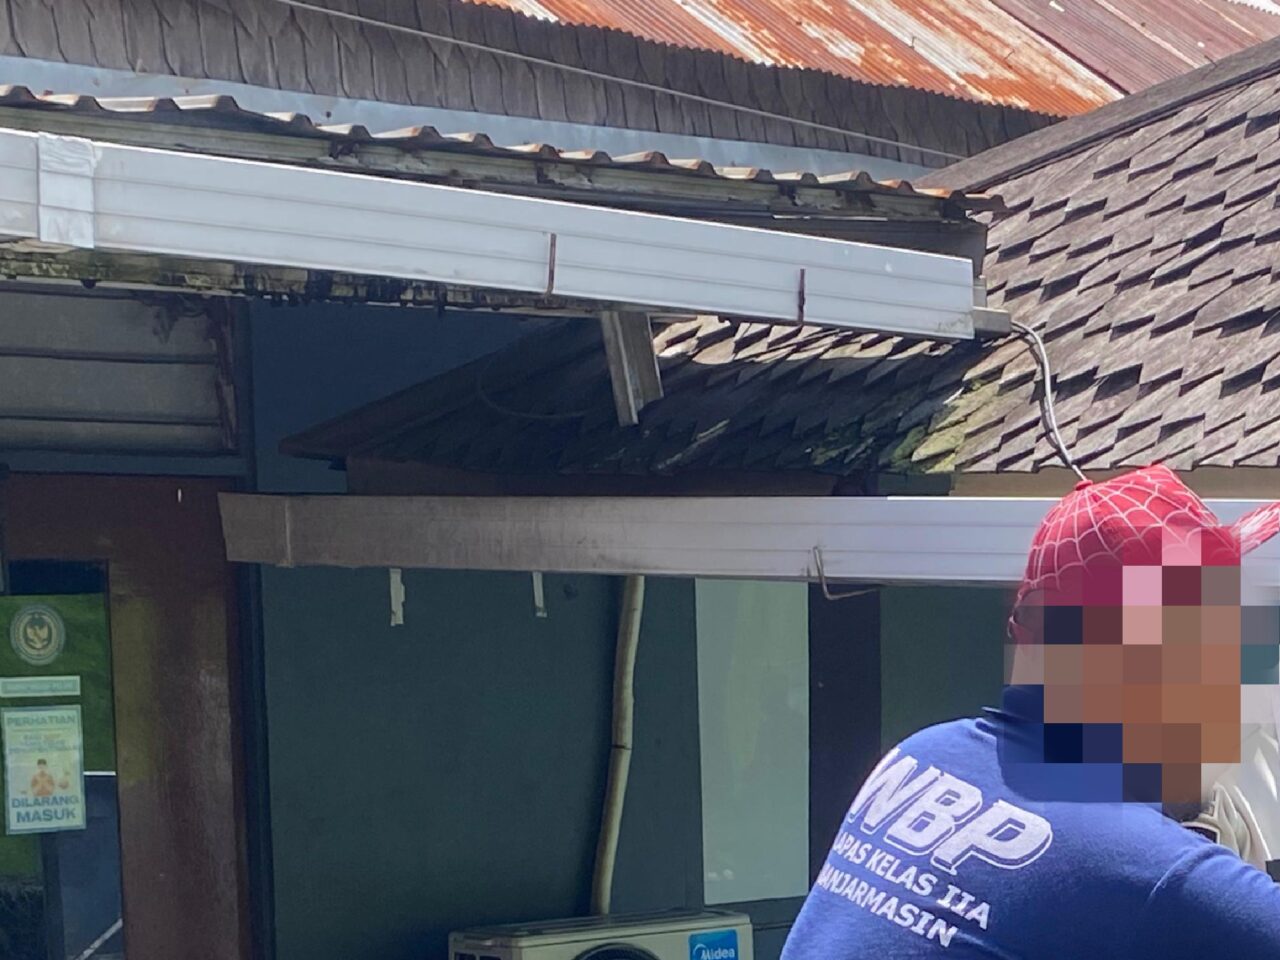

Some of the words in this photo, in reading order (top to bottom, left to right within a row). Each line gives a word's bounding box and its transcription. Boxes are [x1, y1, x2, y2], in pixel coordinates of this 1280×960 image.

[11, 795, 79, 809] DILARANG
[16, 808, 76, 823] MASUK
[865, 848, 938, 896] KELAS
[937, 884, 991, 930] IIA
